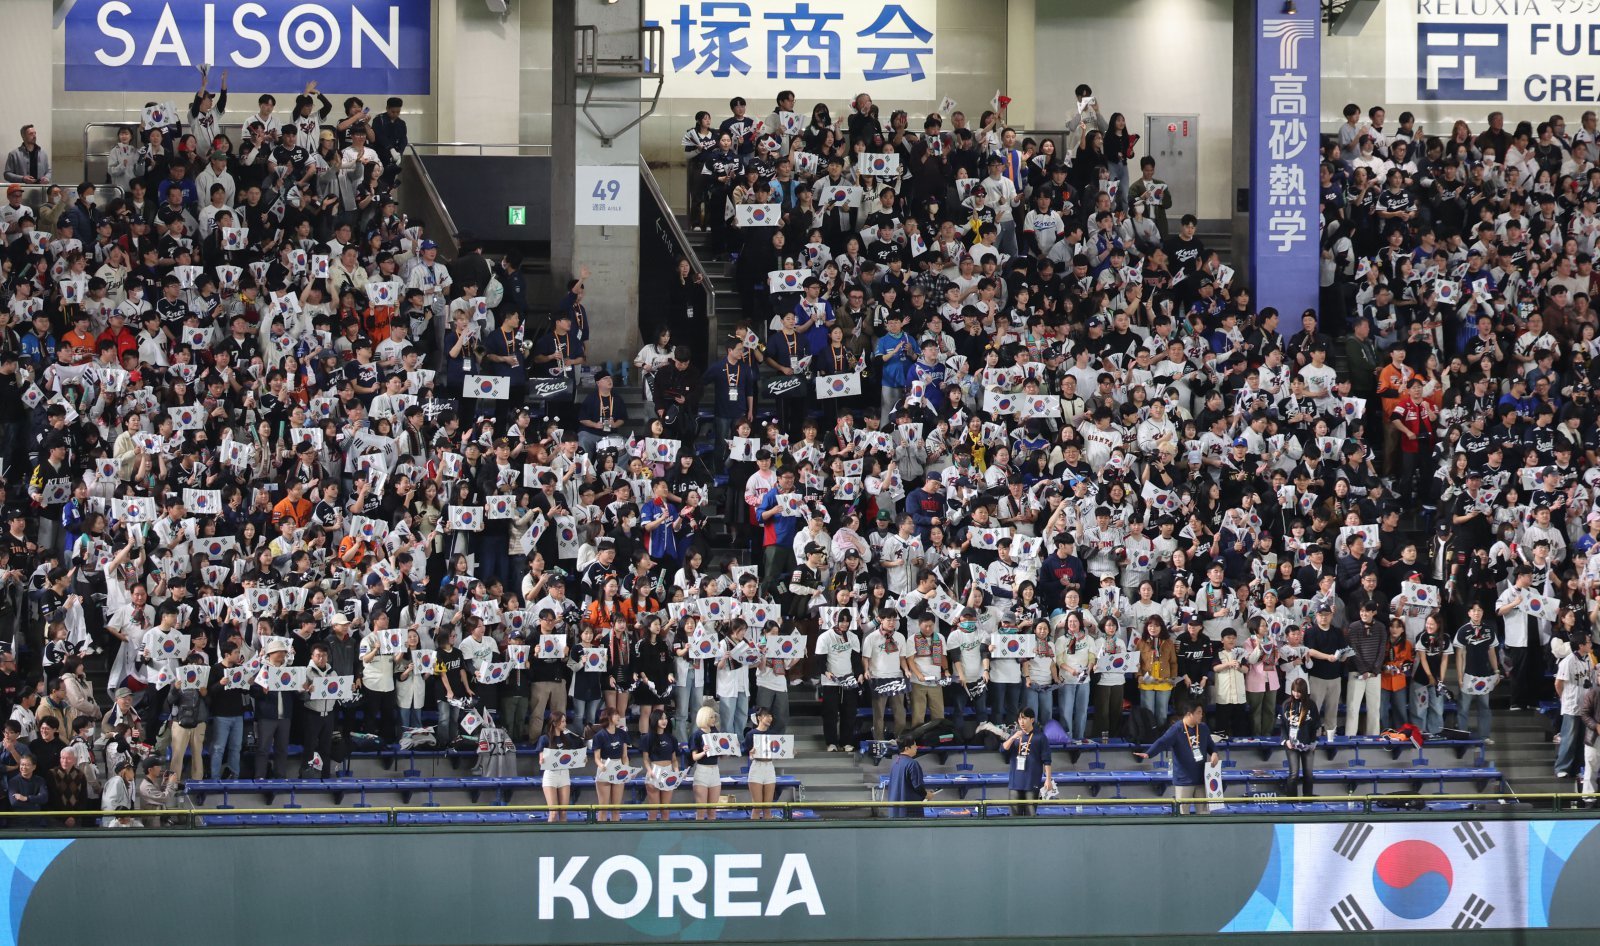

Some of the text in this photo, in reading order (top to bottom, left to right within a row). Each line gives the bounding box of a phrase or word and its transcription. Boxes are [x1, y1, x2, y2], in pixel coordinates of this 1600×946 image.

[1417, 0, 1540, 15] RELUXIA
[94, 1, 400, 69] SAISON
[645, 2, 934, 82] 塚商会
[1524, 74, 1600, 102] CRE
[1268, 72, 1308, 252] 高砂熱学
[592, 180, 621, 201] 49
[535, 381, 568, 397] Korea
[768, 378, 801, 395] Korea
[1087, 434, 1113, 448] GIANTS
[1465, 440, 1490, 453] Korea
[538, 853, 826, 920] KOREA
